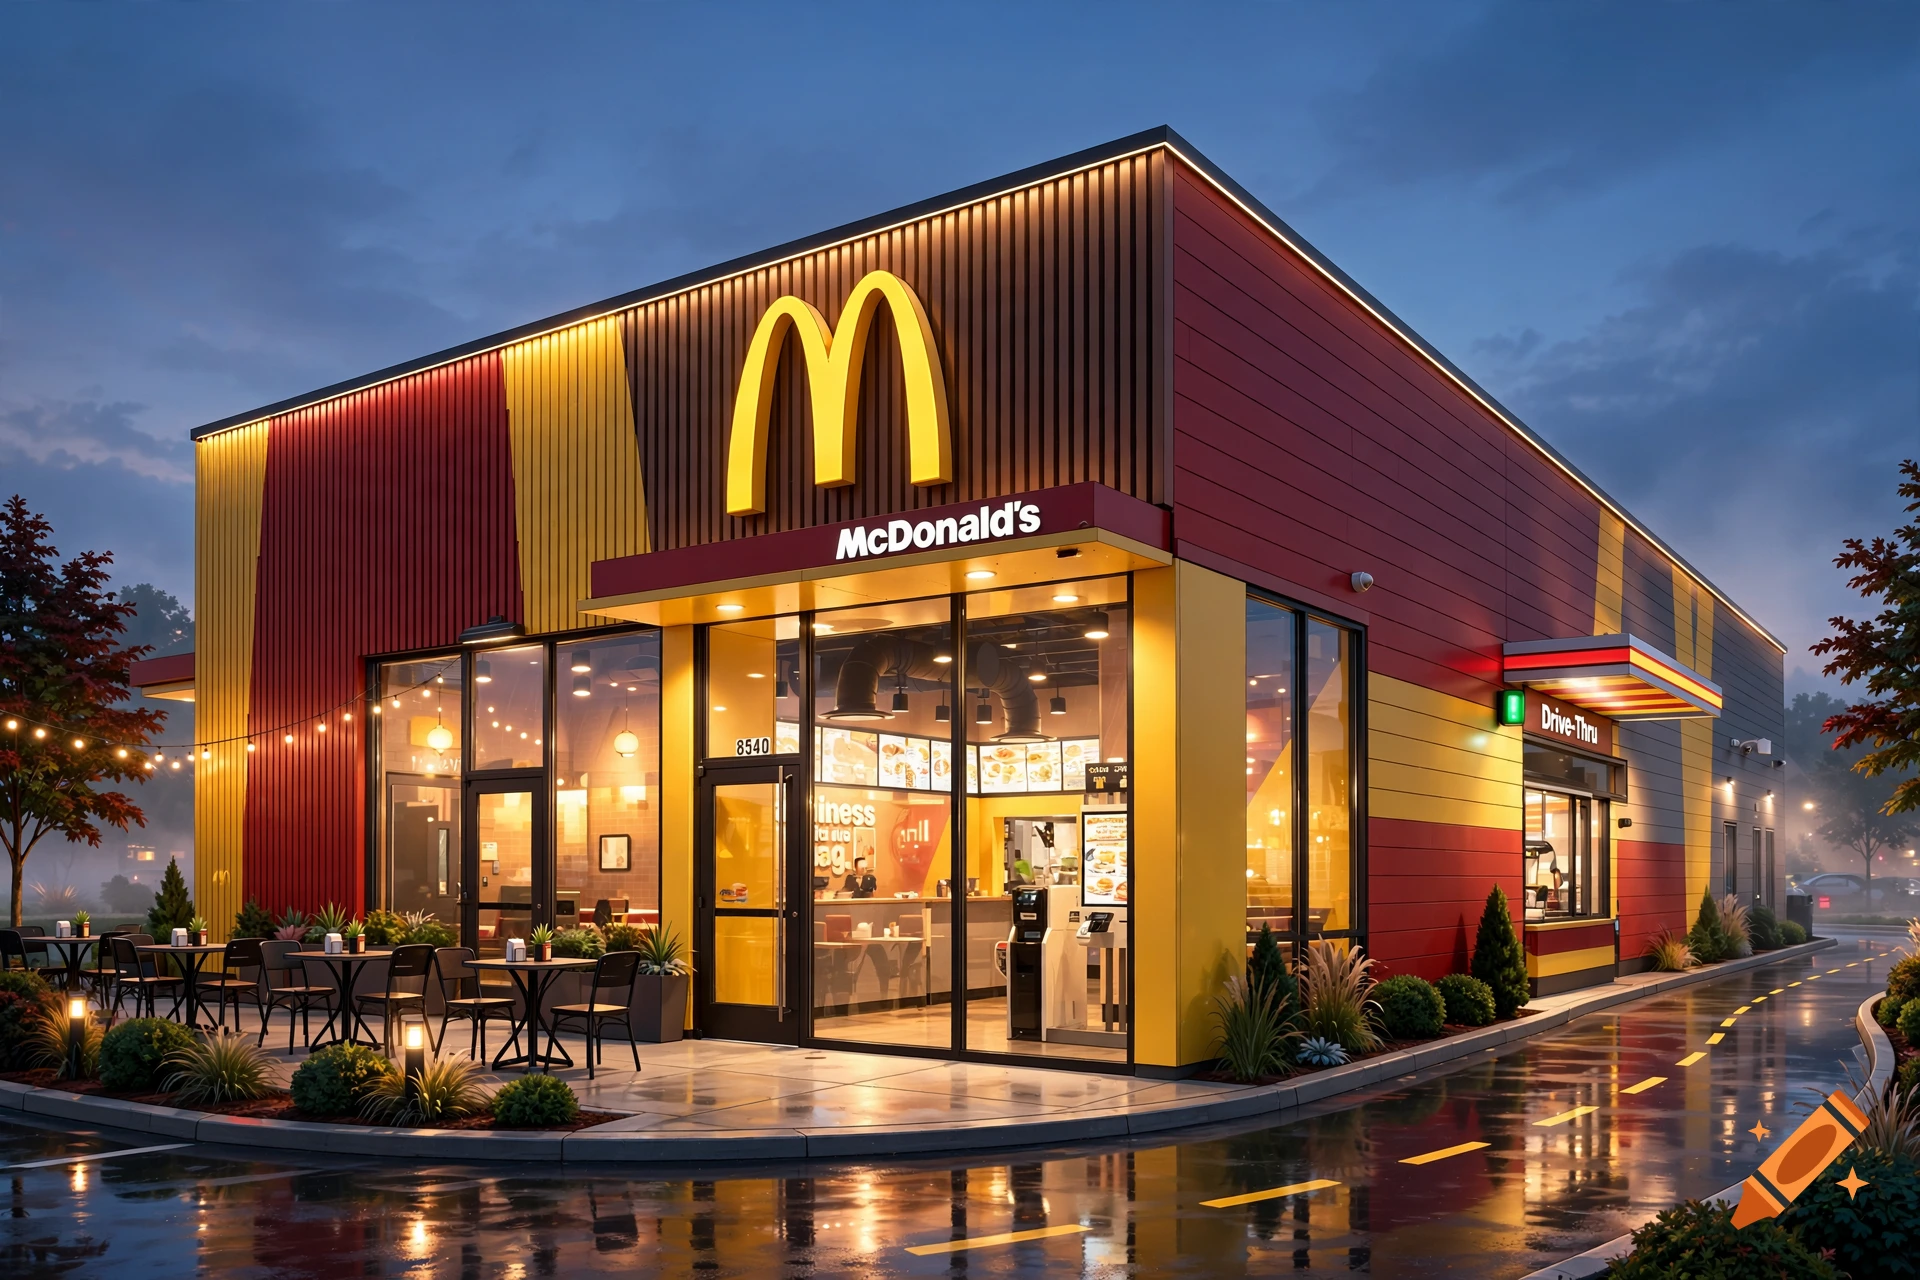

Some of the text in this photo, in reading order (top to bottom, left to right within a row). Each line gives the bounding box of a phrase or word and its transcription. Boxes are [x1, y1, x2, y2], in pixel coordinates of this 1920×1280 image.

[835, 500, 1042, 560] McDonald's
[1541, 703, 1598, 745] Drive-Thru
[736, 737, 769, 755] 8540
